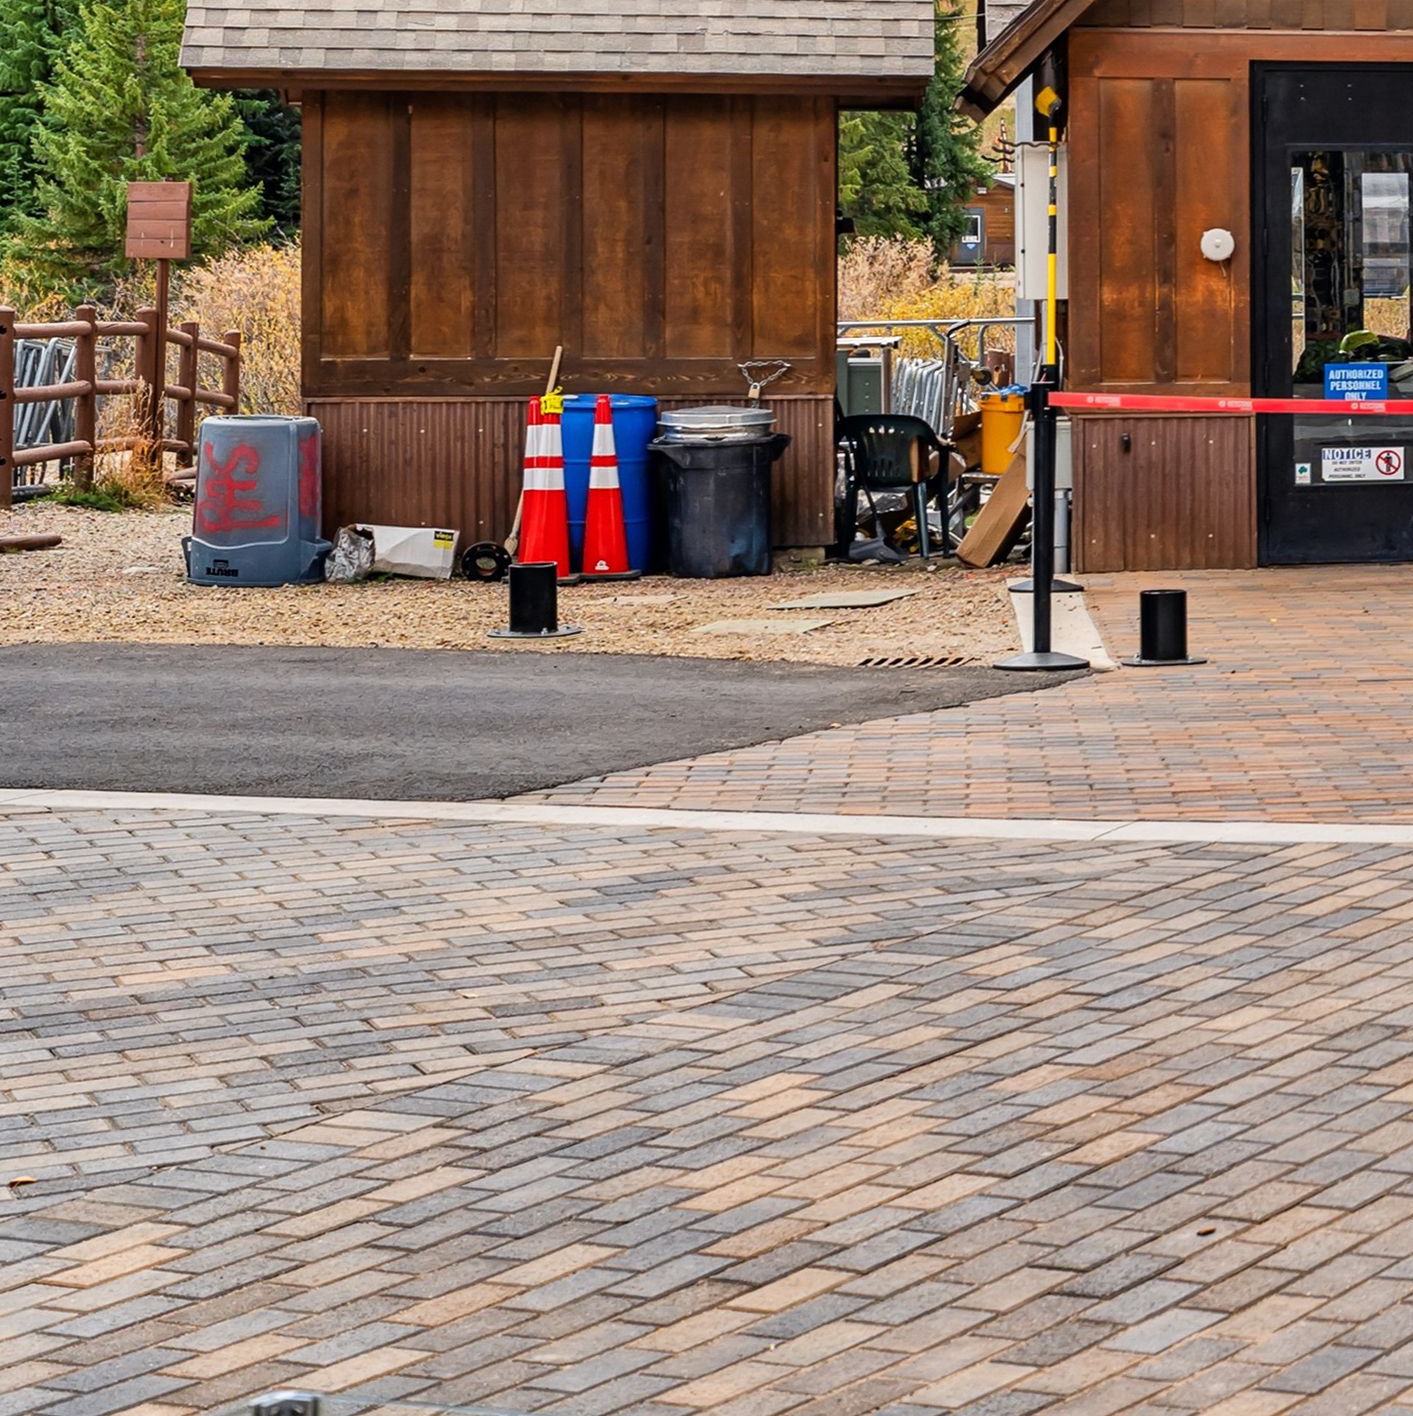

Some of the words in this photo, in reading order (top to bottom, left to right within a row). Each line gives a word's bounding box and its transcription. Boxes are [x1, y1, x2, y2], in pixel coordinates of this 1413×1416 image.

[1328, 369, 1384, 380] AUTHORIZED
[1330, 380, 1381, 391] PERSONNEL
[1344, 391, 1367, 400] ONLY
[1322, 449, 1371, 460] NOTICE
[206, 567, 239, 577] BRUTE
